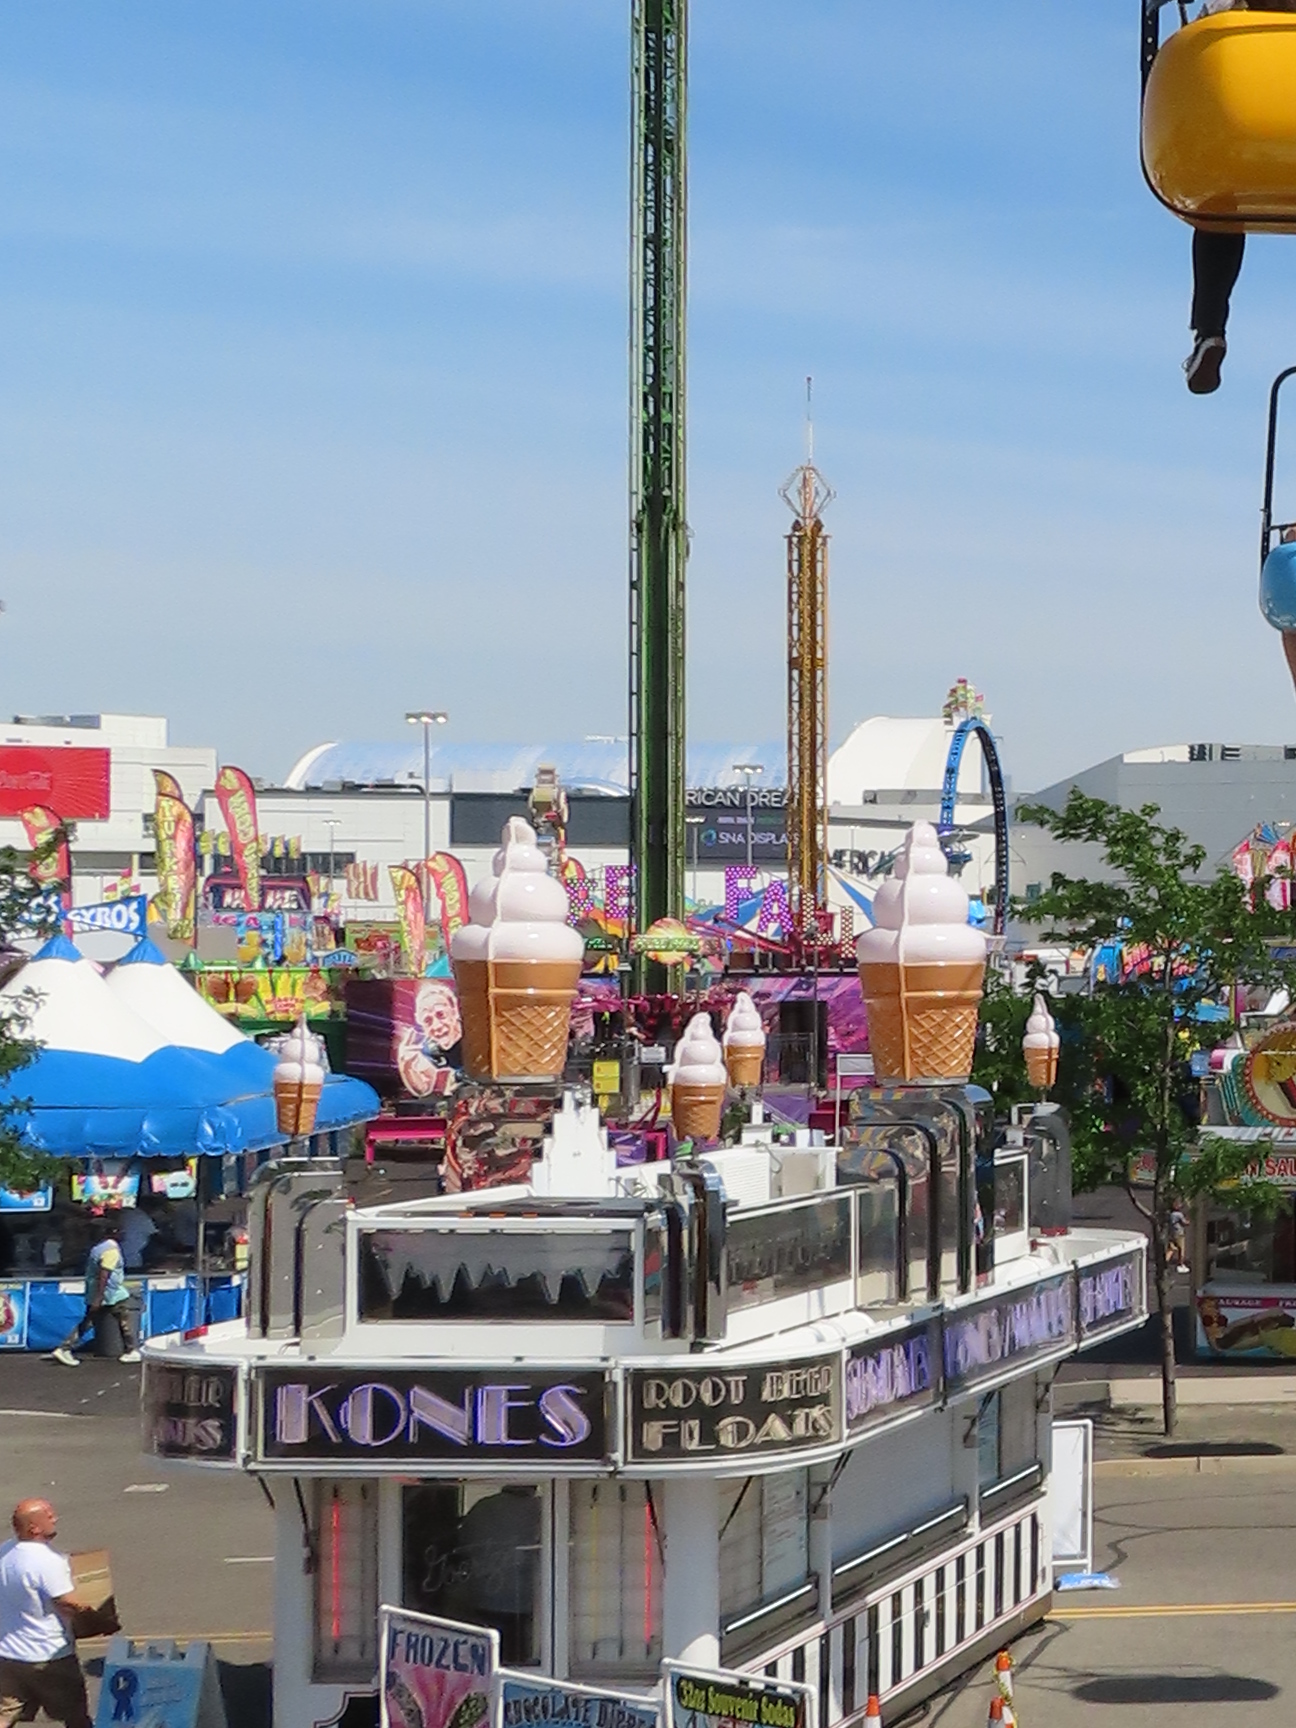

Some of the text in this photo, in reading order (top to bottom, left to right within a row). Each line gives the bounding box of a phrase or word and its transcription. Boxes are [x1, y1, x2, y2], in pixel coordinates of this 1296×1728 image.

[685, 791, 740, 807] RICAN
[747, 833, 800, 845] DISPLAS
[67, 901, 140, 932] GYROS
[643, 1365, 834, 1409] ROOT BEER
[275, 1383, 593, 1447] KONES
[643, 1403, 834, 1451] FLOATS
[391, 1626, 486, 1676] FROZEN
[708, 1685, 758, 1721] Souvenir
[761, 1695, 795, 1728] Sodas
